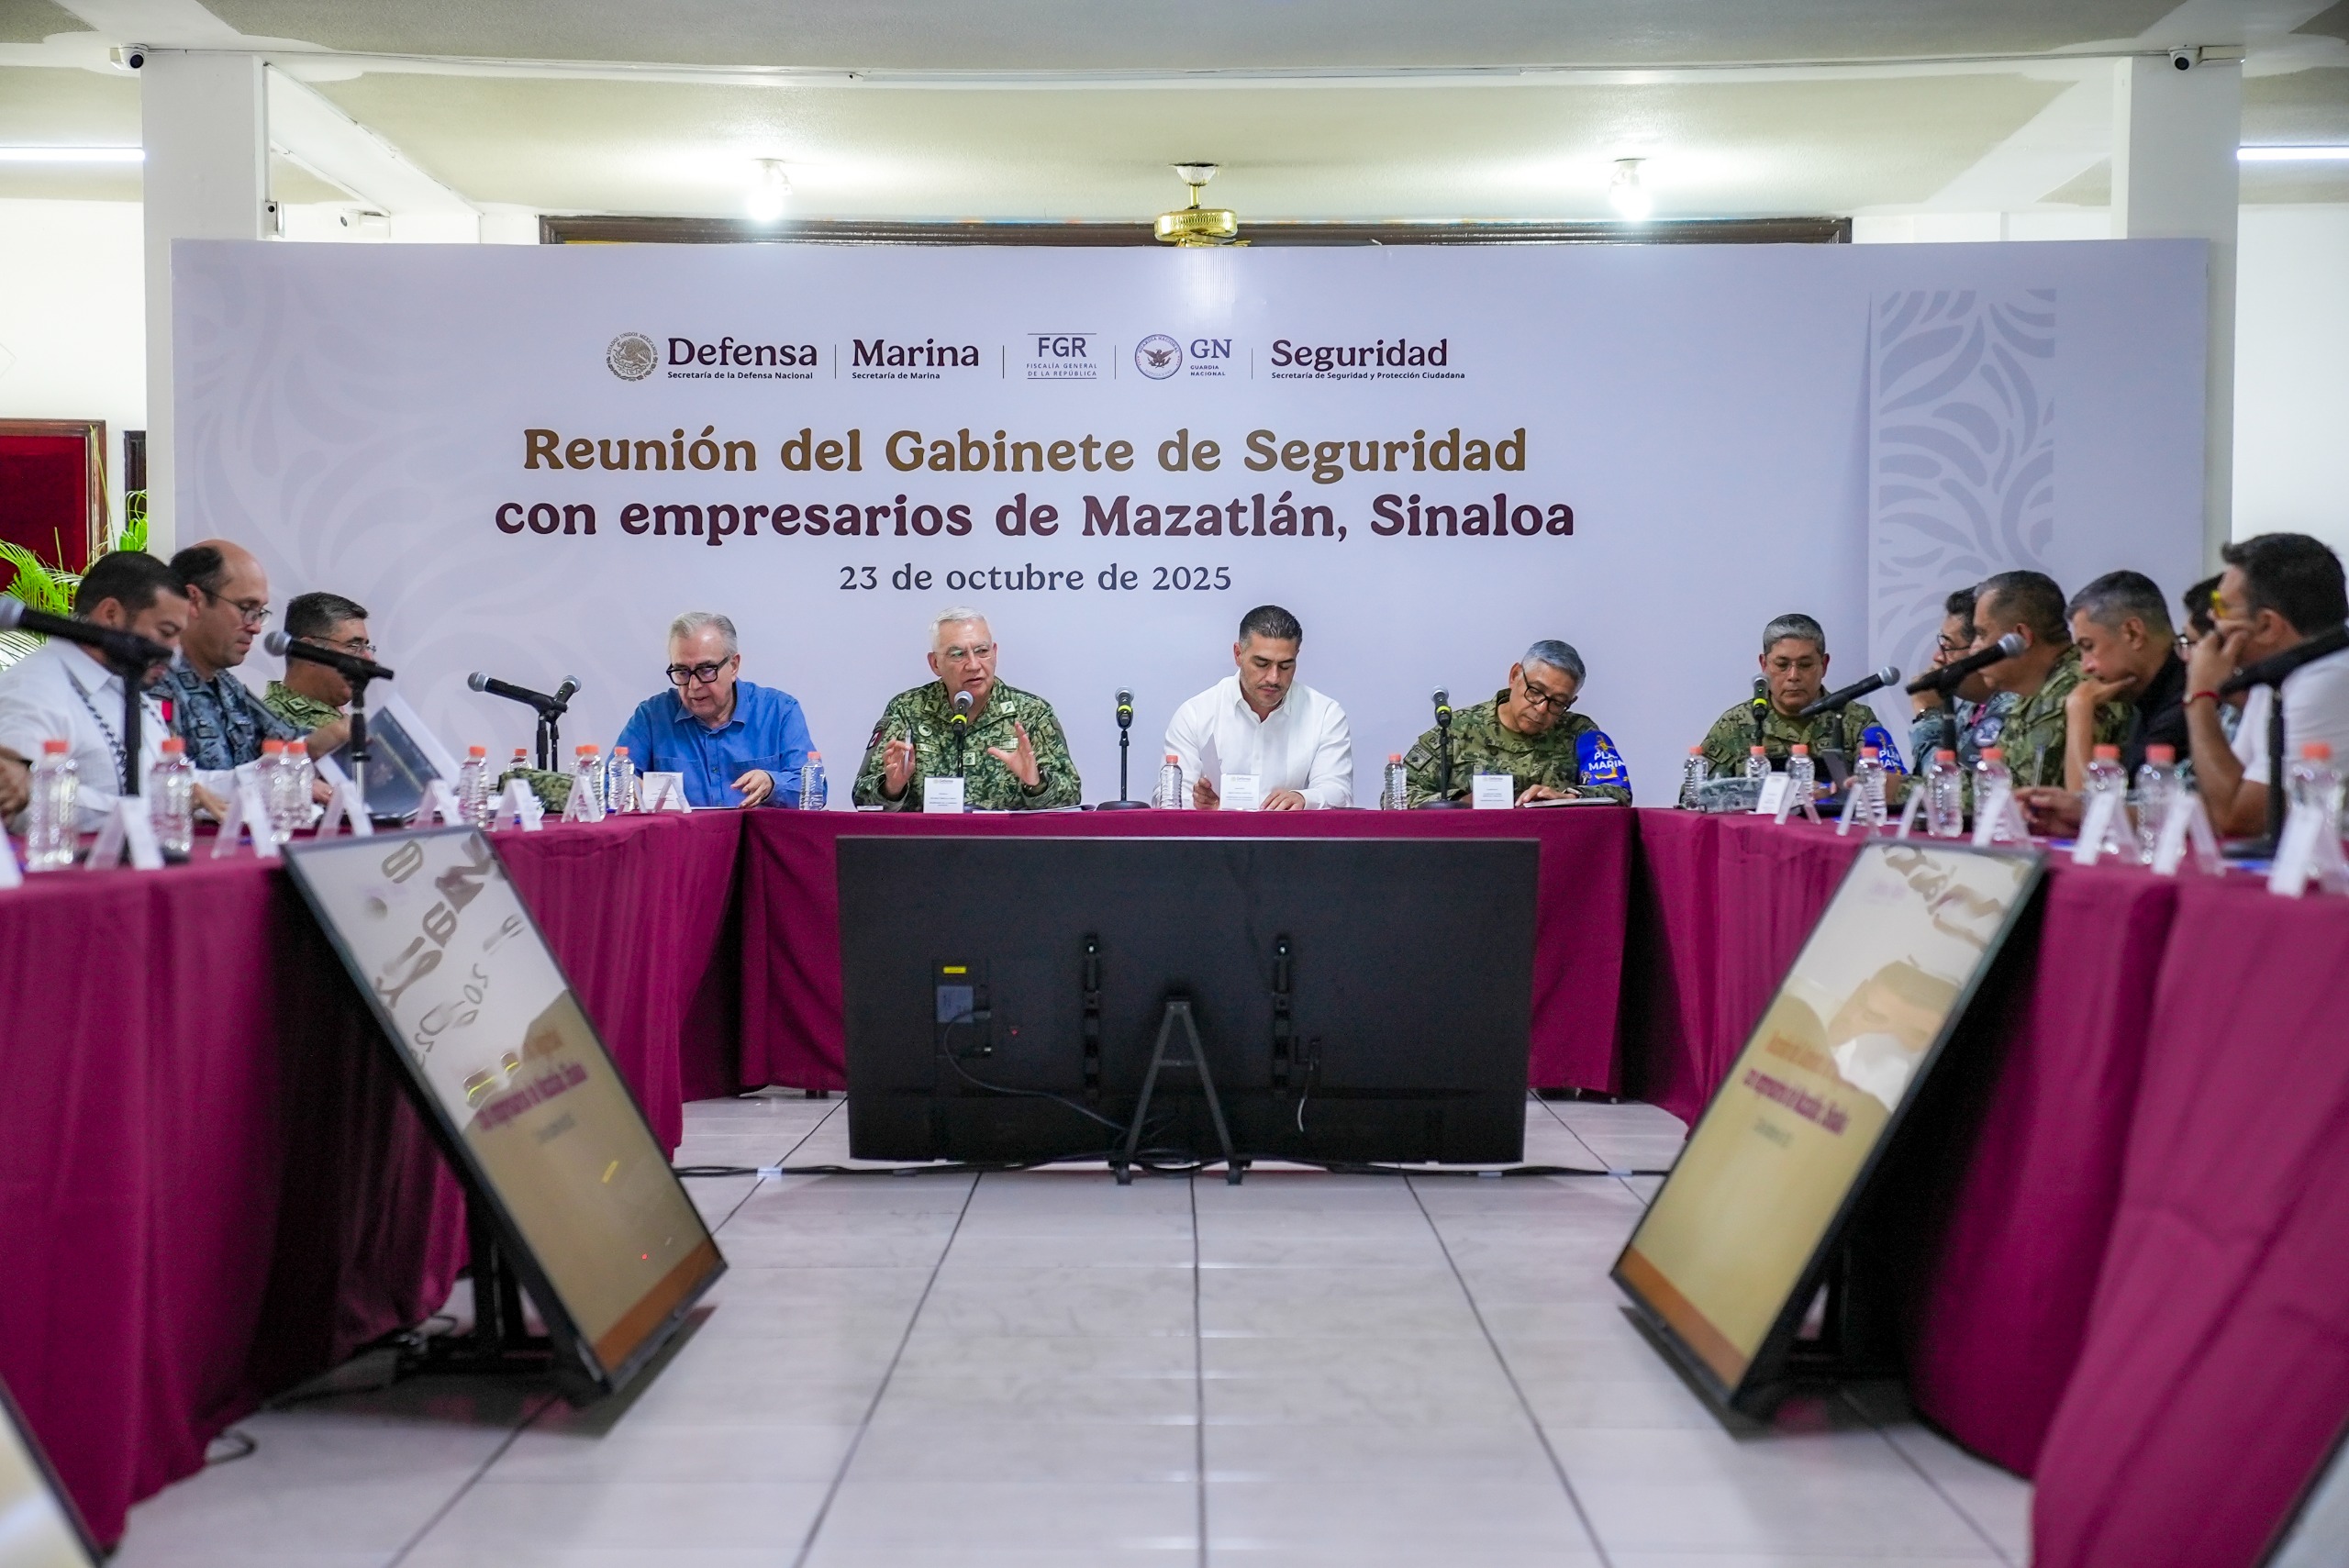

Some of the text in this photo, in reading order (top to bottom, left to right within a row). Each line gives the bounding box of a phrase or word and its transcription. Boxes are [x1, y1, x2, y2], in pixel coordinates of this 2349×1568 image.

[668, 337, 817, 366] Defensa
[852, 339, 979, 366] Marina
[1038, 337, 1086, 357] FGR
[1190, 339, 1232, 359] GN
[1271, 338, 1448, 372] Seguridad
[668, 371, 712, 379] Secretaría
[714, 371, 726, 379] de
[727, 371, 736, 379] la
[737, 371, 773, 379] Defensa
[852, 371, 896, 379] Secretaría
[897, 371, 908, 379] de
[1327, 372, 1368, 381] Seguridad
[1370, 373, 1375, 381] y
[1376, 371, 1420, 379] Protección
[524, 424, 1526, 484] Reunión del Gabinete de Seguridad
[495, 491, 1575, 546] con empresarios de Mazatlán, Sinaloa
[841, 562, 1230, 591] 23 de octubre de 2025
